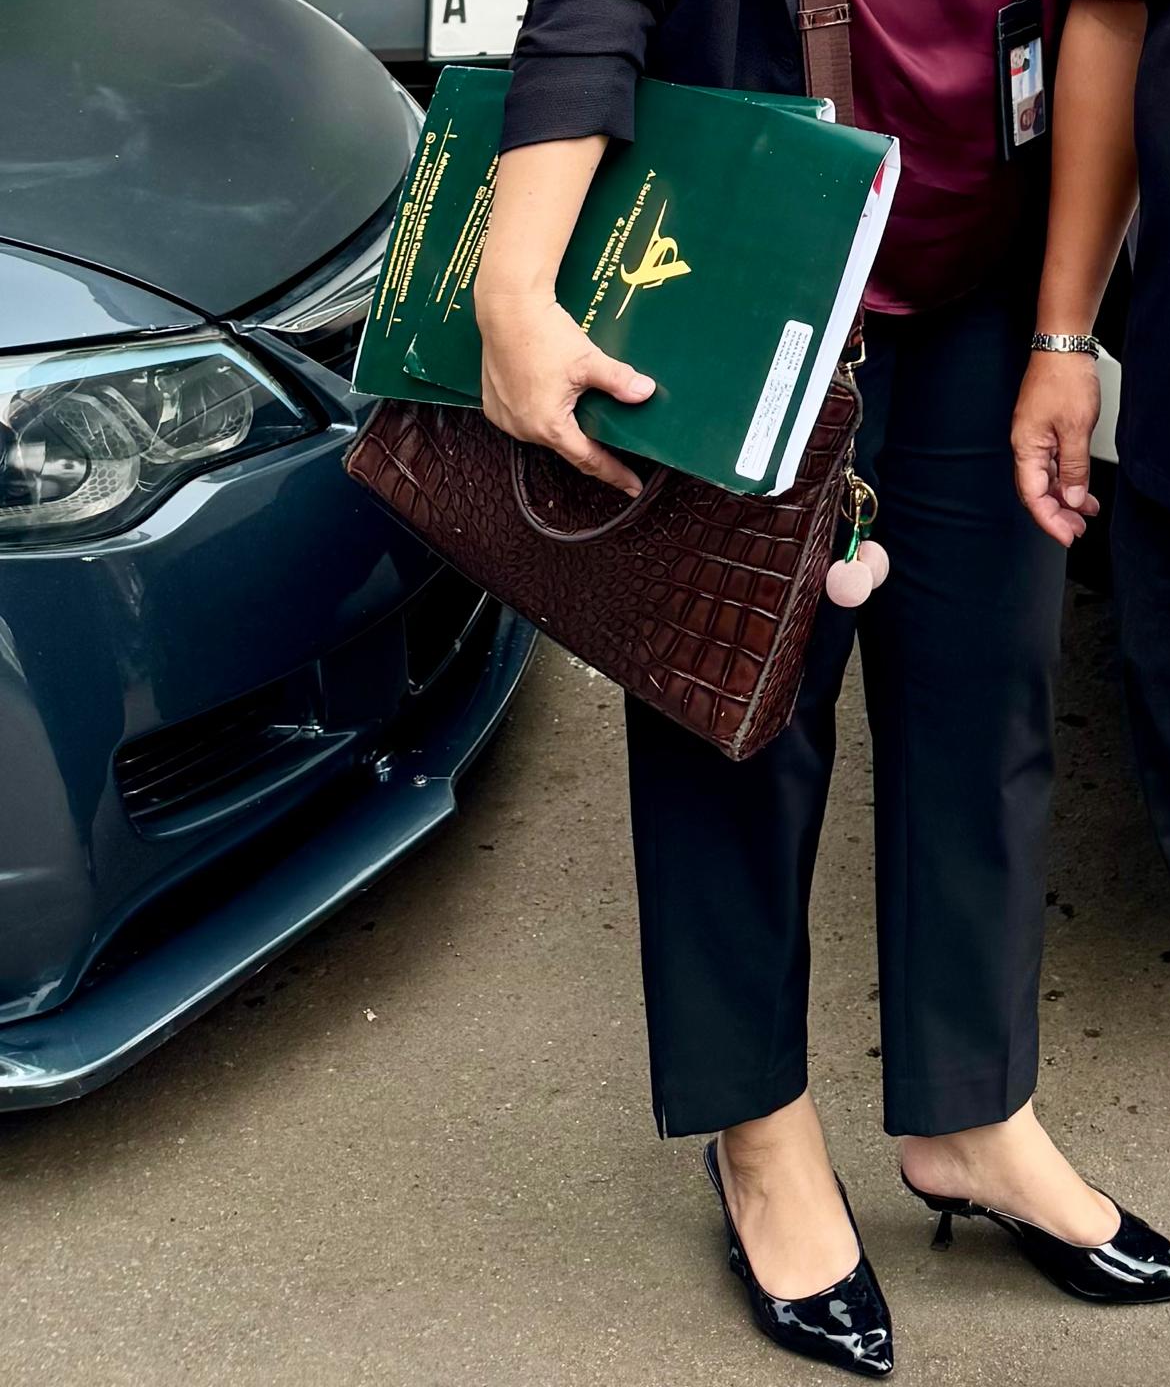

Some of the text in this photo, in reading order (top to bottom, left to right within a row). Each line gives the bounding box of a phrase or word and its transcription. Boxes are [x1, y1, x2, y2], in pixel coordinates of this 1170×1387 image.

[426, 151, 451, 202] Advocates
[635, 182, 652, 206] Sari
[646, 168, 657, 181] A.
[414, 212, 430, 241] Legal
[591, 217, 626, 281] & Associates
[610, 206, 642, 264] Damayanti
[397, 241, 421, 303] Consultants
